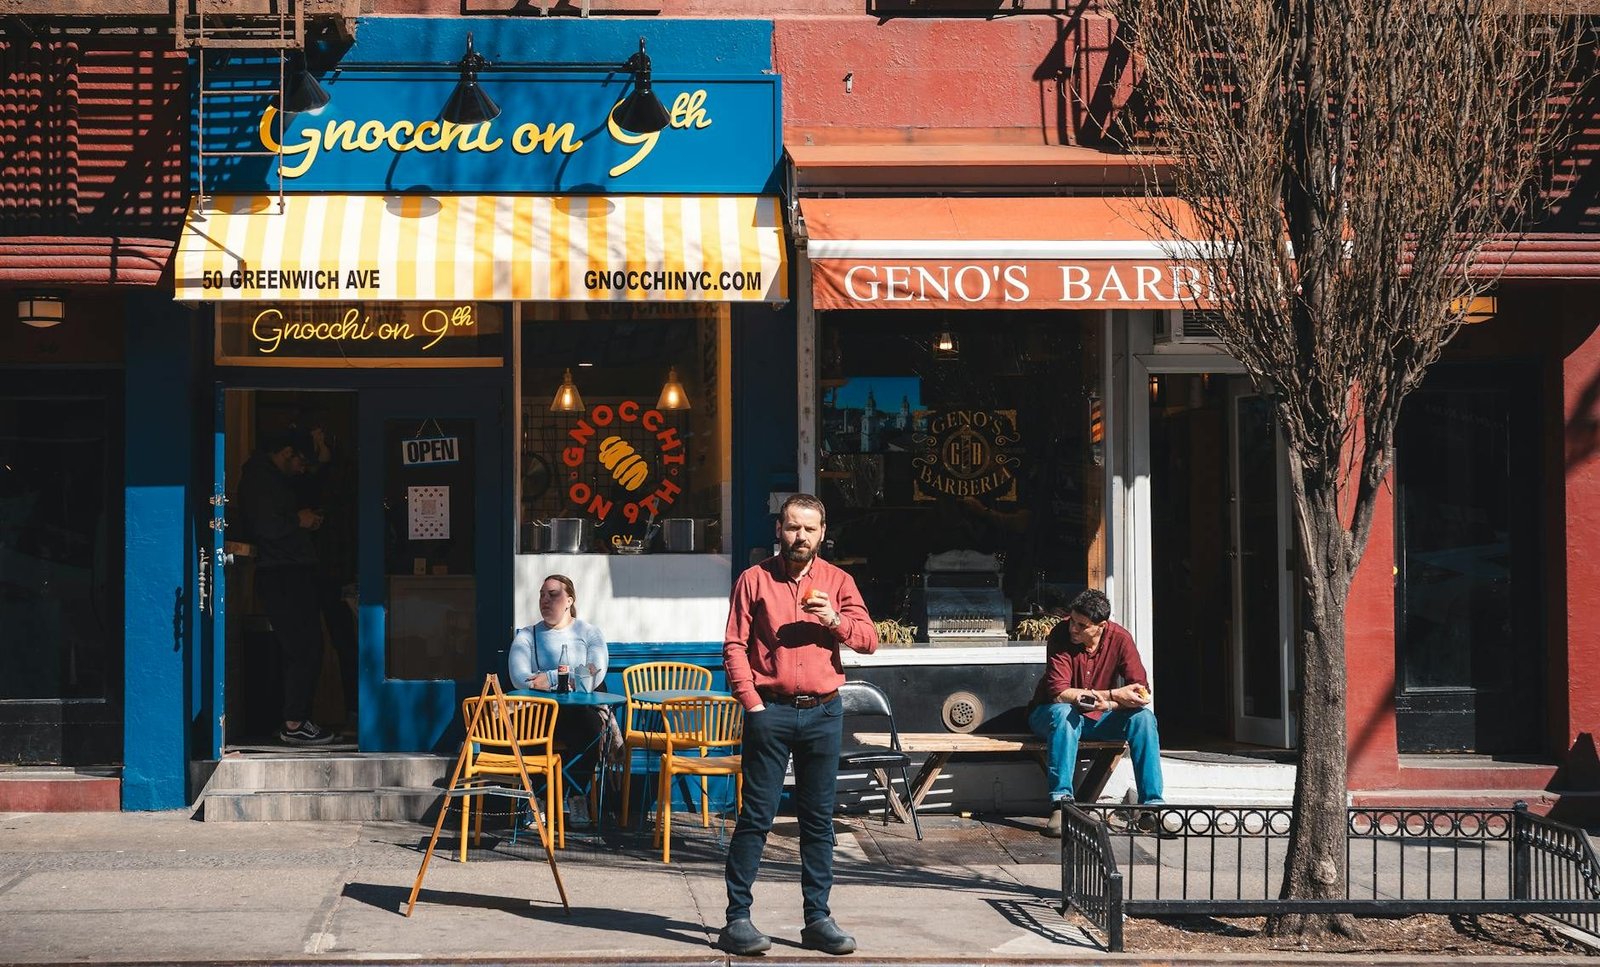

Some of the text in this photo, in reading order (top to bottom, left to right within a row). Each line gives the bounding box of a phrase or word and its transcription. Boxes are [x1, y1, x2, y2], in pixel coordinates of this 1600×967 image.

[511, 121, 584, 154] on
[202, 269, 381, 290] 50 GREENWICH AVE
[584, 270, 762, 291] GNOCCHINYC.COM
[843, 264, 1031, 303] GENO'S
[252, 308, 374, 353] Gnocchi
[378, 320, 415, 341] on
[421, 304, 475, 351] 9th
[562, 400, 685, 468] GNOCCHI
[931, 410, 1001, 435] GENO'S
[407, 438, 455, 464] OPEN
[920, 465, 1012, 497] BARBERIA
[568, 478, 682, 524] ON 9TH
